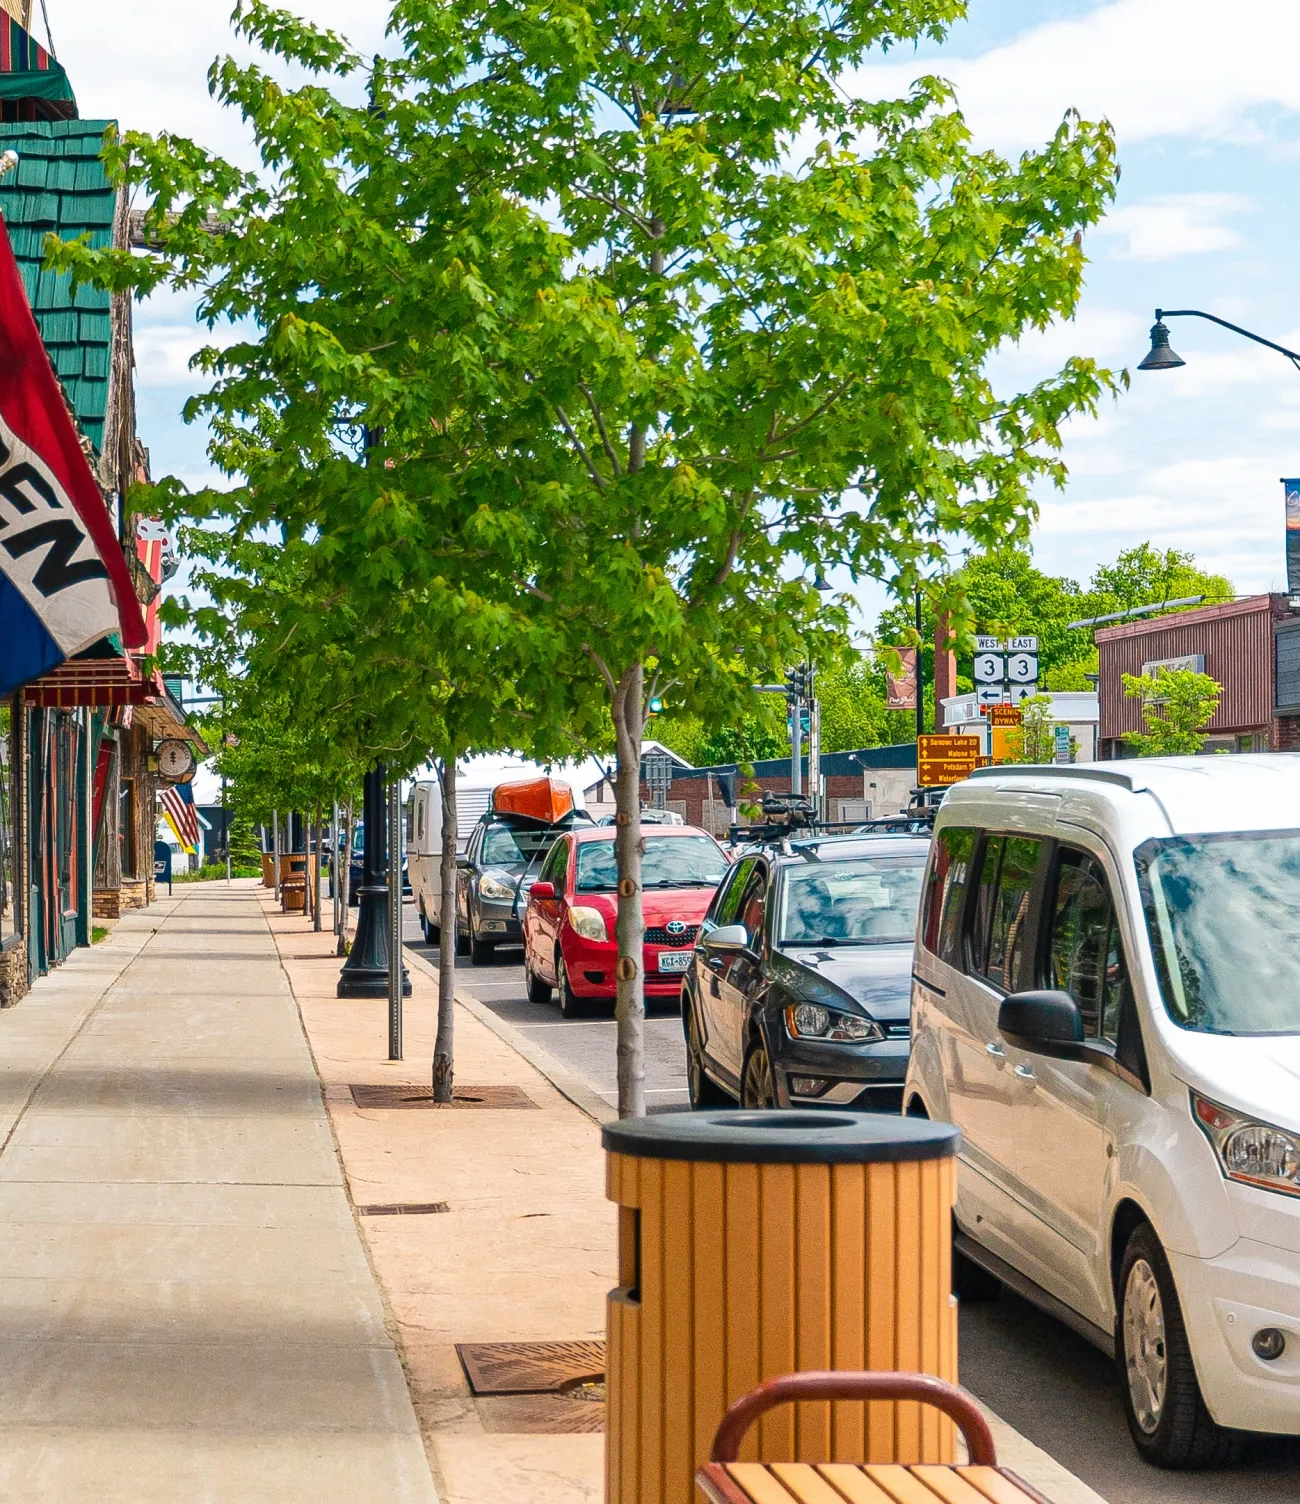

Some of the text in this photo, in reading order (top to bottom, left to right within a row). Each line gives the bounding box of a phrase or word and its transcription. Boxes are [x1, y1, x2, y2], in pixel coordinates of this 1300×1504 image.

[978, 638, 999, 648] WEST
[1012, 638, 1032, 648] EAST
[984, 659, 995, 676] 3
[1017, 659, 1029, 676] 3
[994, 717, 1019, 725] BYWAY
[953, 738, 967, 746] Lake
[943, 763, 967, 771] Potsdam
